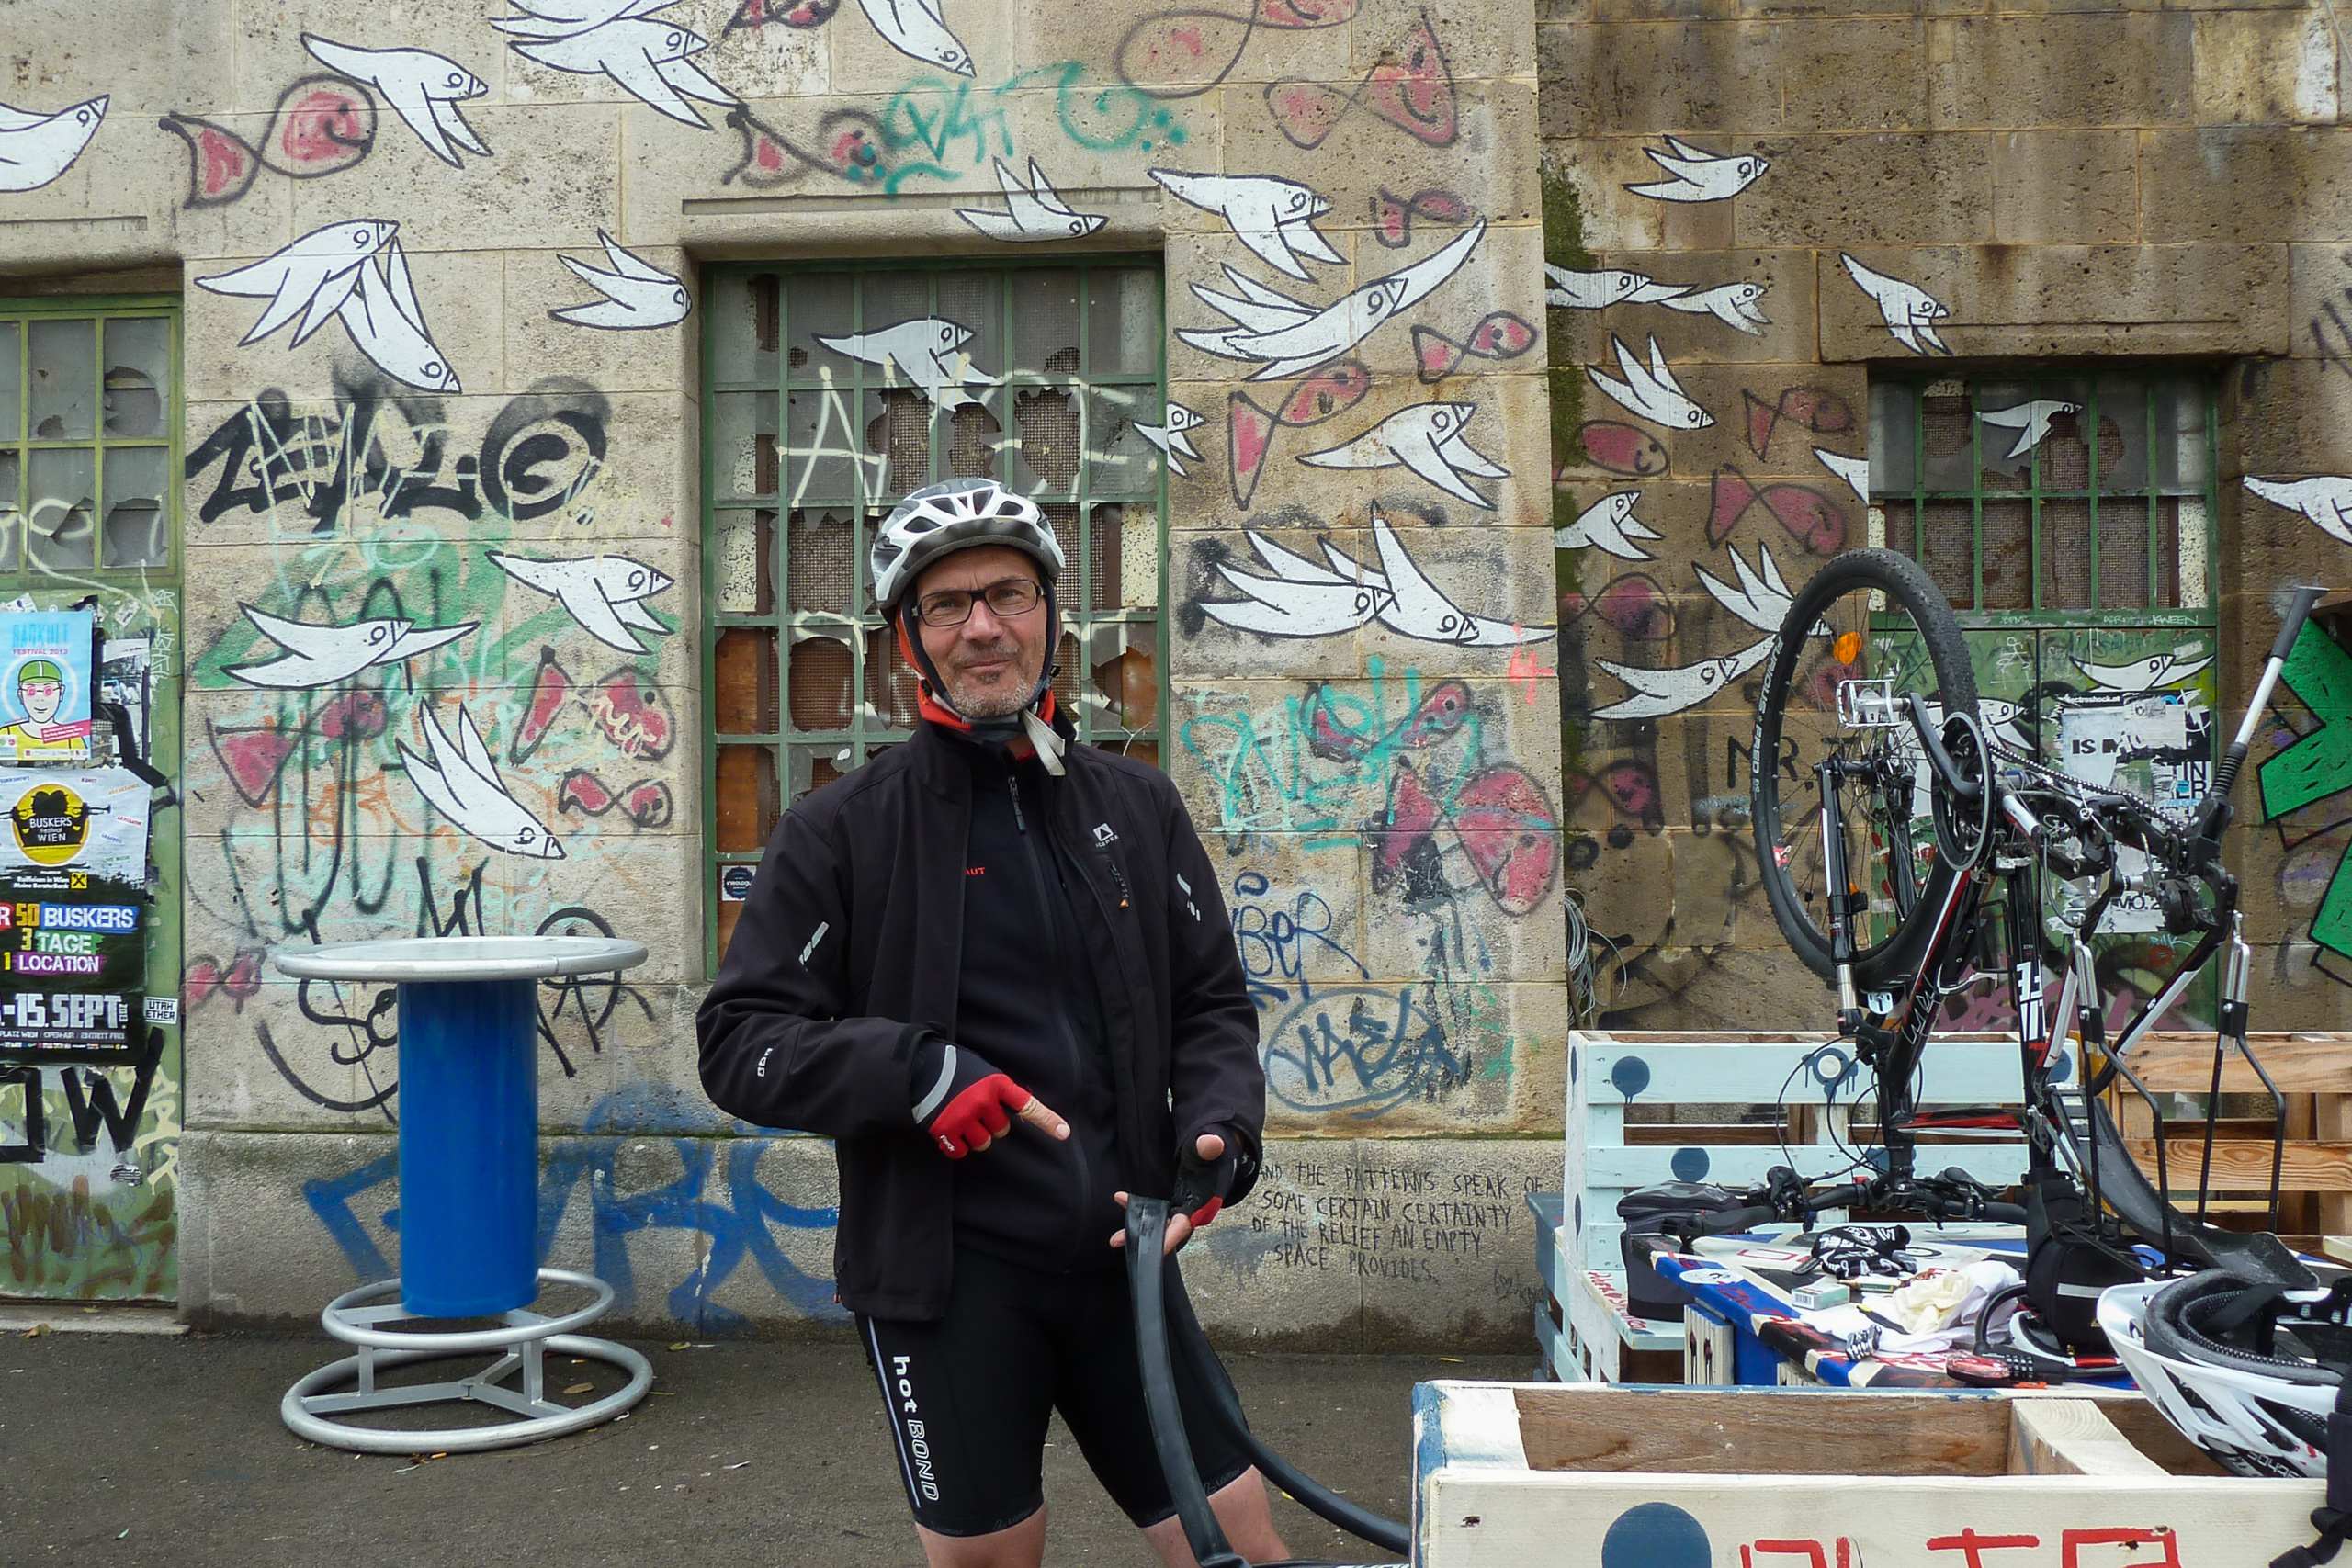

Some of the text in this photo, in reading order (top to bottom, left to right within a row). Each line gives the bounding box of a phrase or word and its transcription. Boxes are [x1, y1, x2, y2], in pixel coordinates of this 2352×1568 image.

[1752, 724, 1762, 774] FRED
[2072, 739, 2097, 754] IS
[29, 817, 73, 828] BUSKERS
[38, 833, 66, 841] WIEN
[16, 903, 40, 927] 50
[44, 908, 134, 928] BUSKERS
[21, 928, 92, 954] 3 TAGE
[4, 952, 99, 972] 1 LOCATION
[146, 1010, 175, 1020] ETHER
[1452, 1172, 1510, 1200] SPEAK
[1524, 1176, 1544, 1193] OF
[1261, 1190, 1512, 1234] SOME CERTAIN CERTAINTY
[1252, 1217, 1271, 1233] OF
[1318, 1222, 1382, 1251] RELIEF
[1391, 1224, 1415, 1250] AN
[1424, 1228, 1481, 1258] EMPTY
[1274, 1243, 1329, 1271] SPACE
[893, 1355, 940, 1502] hot BOND
